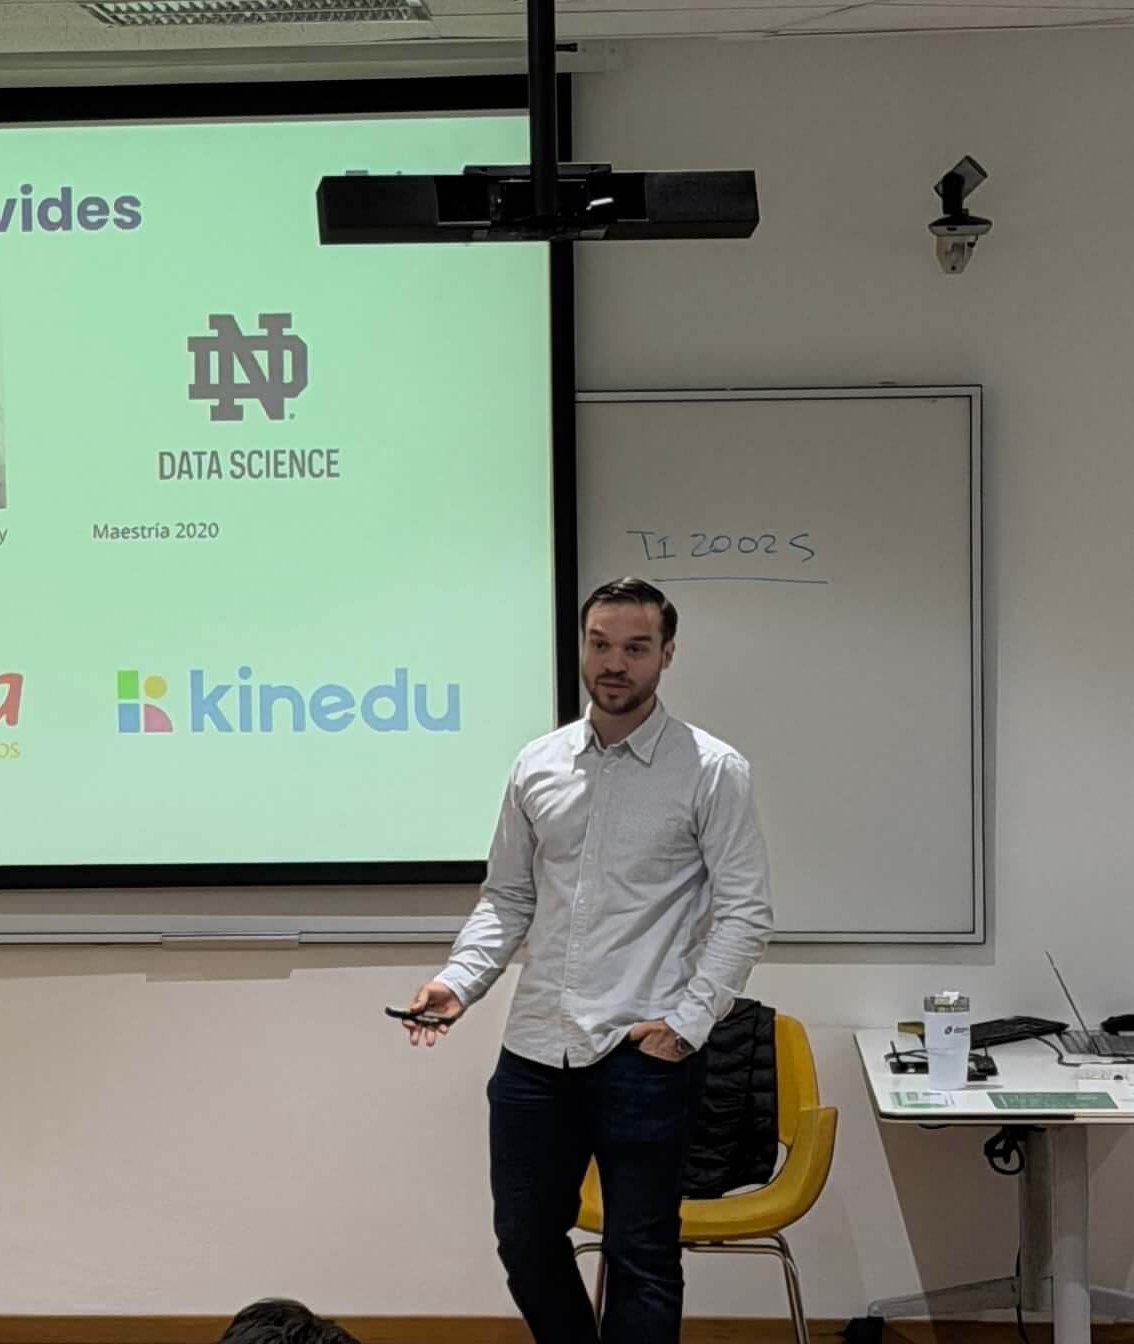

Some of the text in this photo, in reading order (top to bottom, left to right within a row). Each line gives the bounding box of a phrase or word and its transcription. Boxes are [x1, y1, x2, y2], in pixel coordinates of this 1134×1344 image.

[159, 449, 340, 480] DATA SCIENCE
[92, 522, 219, 539] Maestría 2020
[191, 665, 461, 734] kinedu
